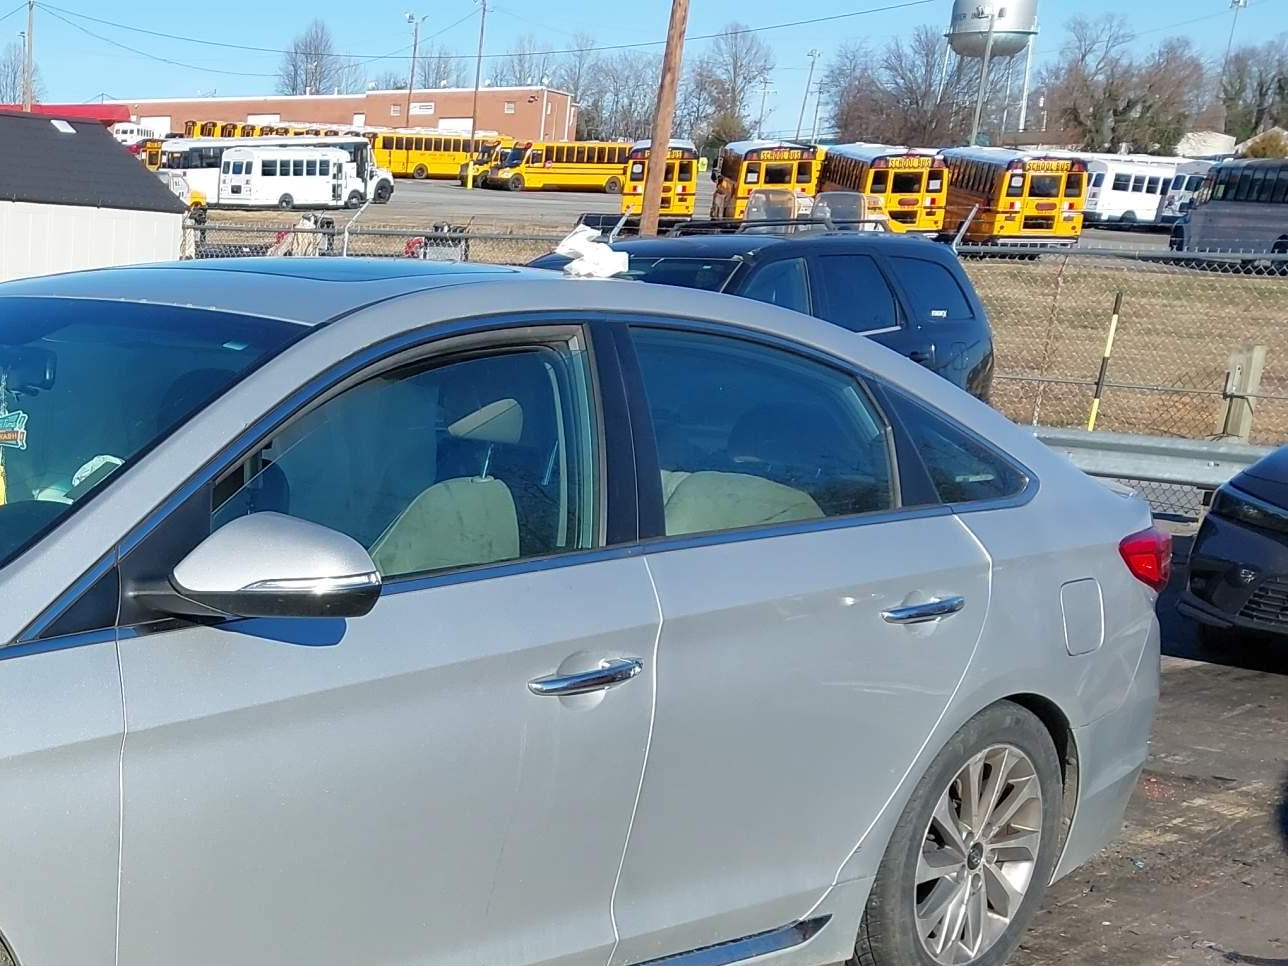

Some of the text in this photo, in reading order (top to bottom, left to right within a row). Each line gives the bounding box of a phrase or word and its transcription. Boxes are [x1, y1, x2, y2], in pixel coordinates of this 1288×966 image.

[761, 151, 801, 160] SCHOOL BUS
[890, 158, 930, 169] SCHOOL BUS
[1027, 162, 1070, 171] SCHOOL BUS
